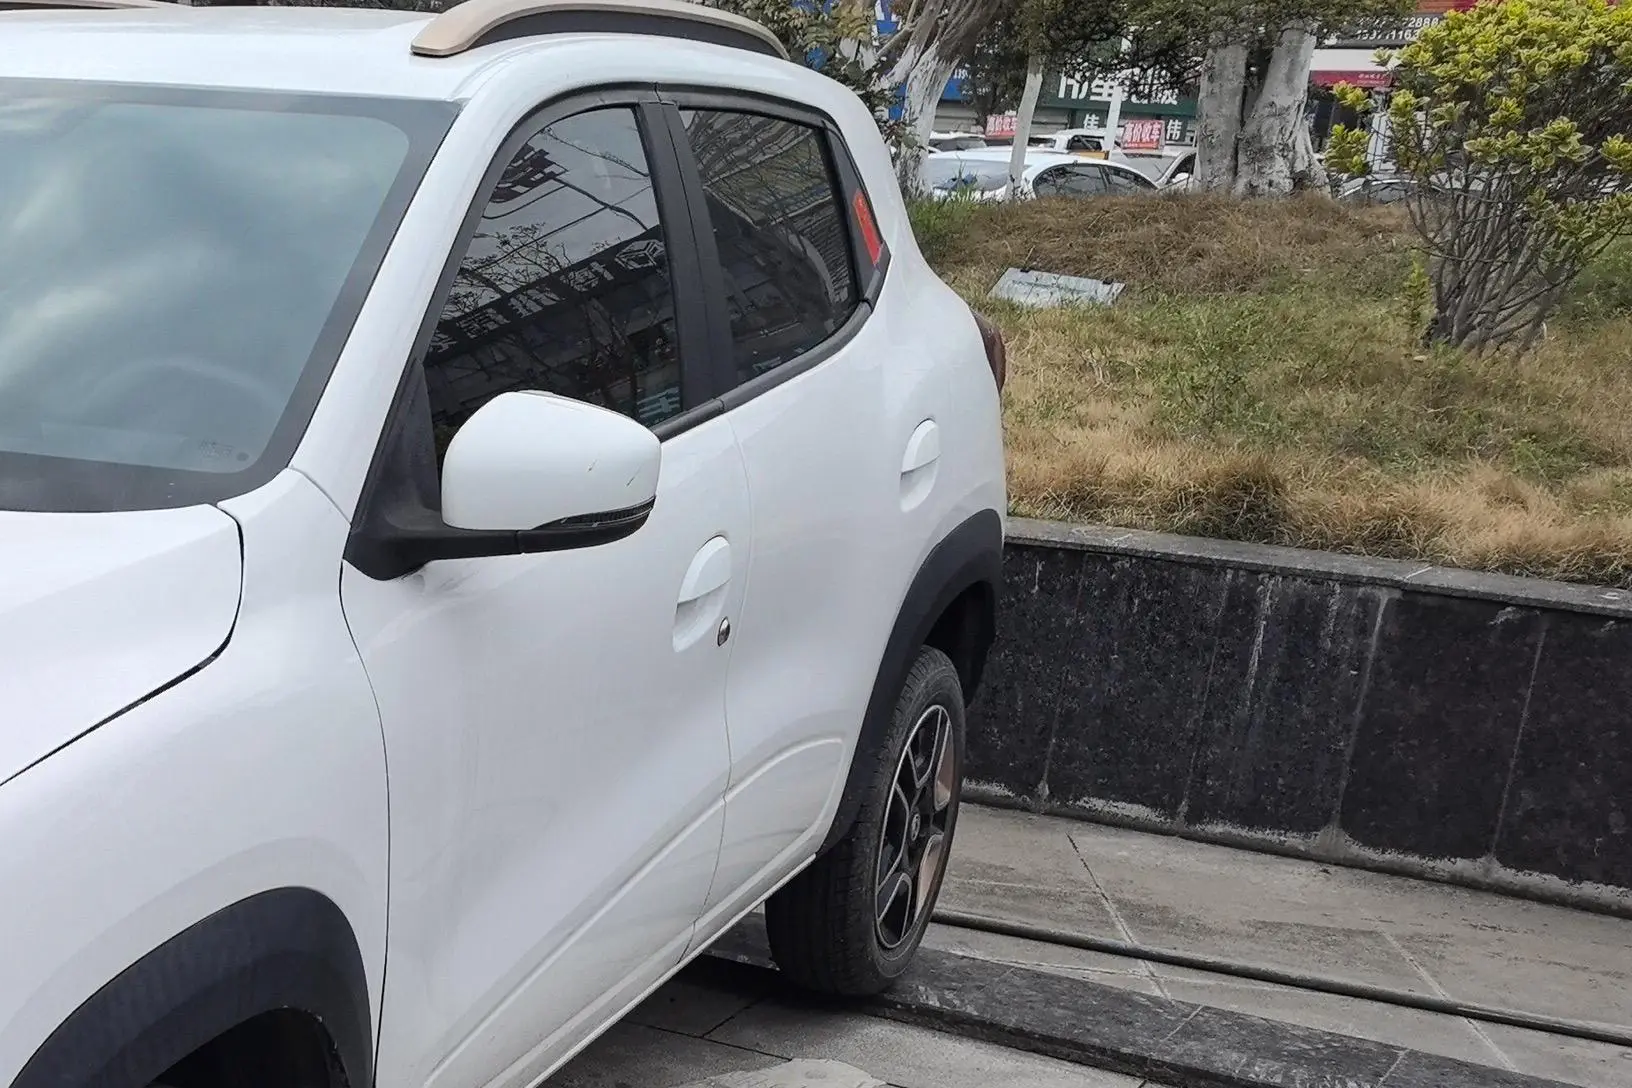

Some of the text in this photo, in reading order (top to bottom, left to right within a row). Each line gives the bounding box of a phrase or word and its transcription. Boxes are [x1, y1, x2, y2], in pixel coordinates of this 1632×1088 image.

[1123, 122, 1161, 142] 高价收车
[1166, 119, 1183, 141] 伟
